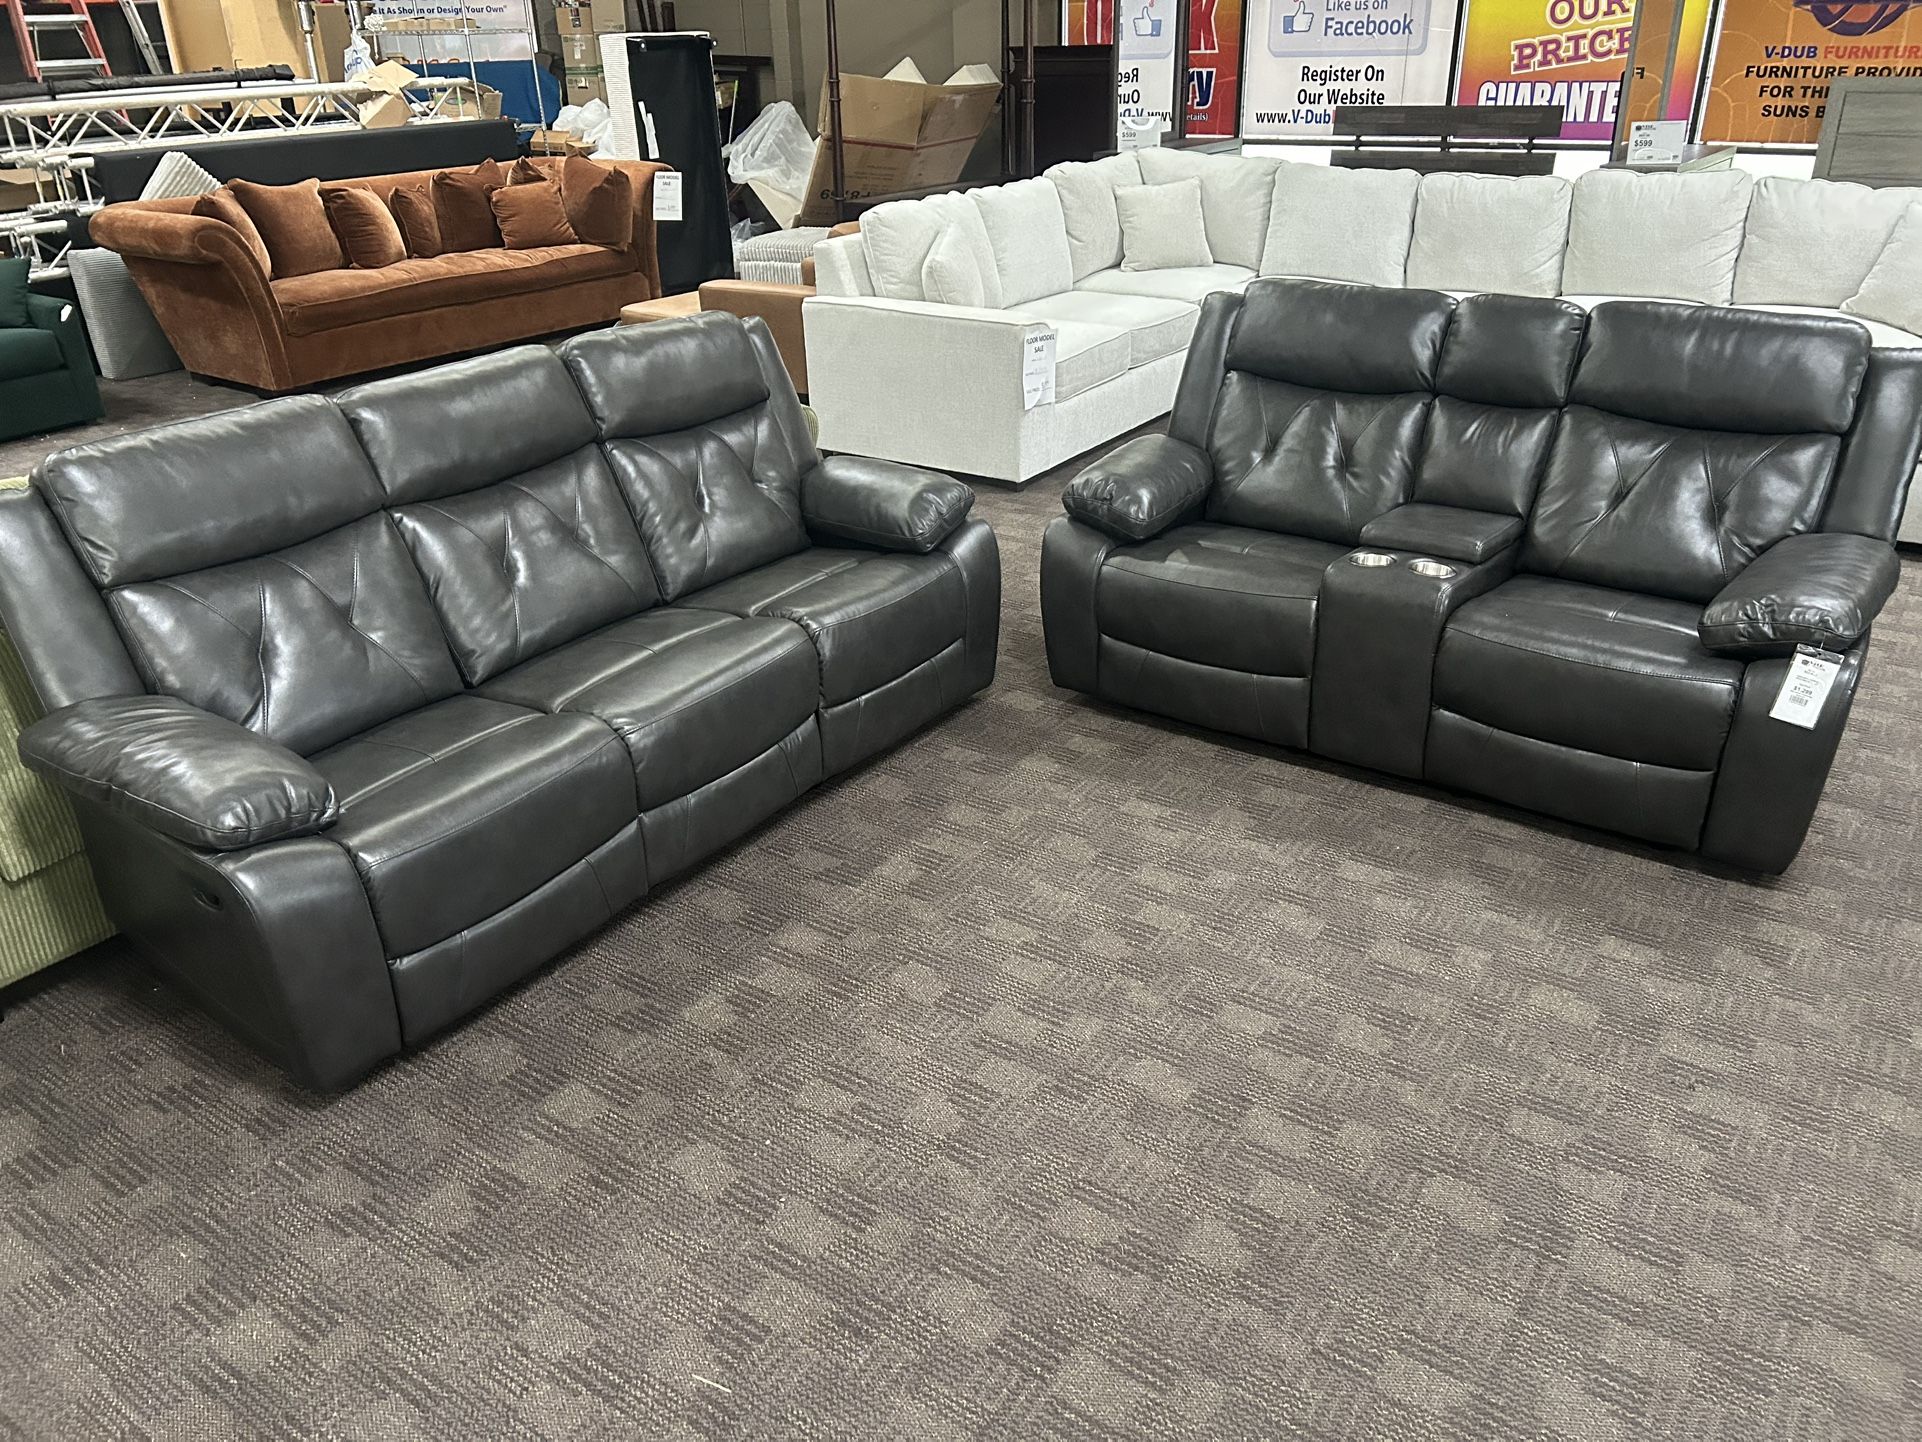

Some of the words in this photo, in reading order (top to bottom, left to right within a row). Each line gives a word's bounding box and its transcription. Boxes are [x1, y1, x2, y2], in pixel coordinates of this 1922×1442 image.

[379, 7, 385, 15] It
[465, 5, 484, 13] Your
[1326, 0, 1351, 11] Like
[1355, 0, 1369, 10] us
[1372, 0, 1388, 10] on
[1324, 13, 1414, 37] Facebook
[1764, 46, 1818, 59] V-DUB
[1823, 45, 1922, 60] FURNITUR
[1301, 65, 1361, 86] Register
[1364, 65, 1385, 82] On
[1854, 65, 1922, 77] PROVID
[1297, 88, 1324, 105] Our
[1326, 88, 1385, 105] Website
[1758, 85, 1795, 98] FOR
[1477, 80, 1621, 123] GUARANTE
[1186, 113, 1209, 121] etails)
[1255, 109, 1336, 124] www.V-Dub
[1761, 104, 1810, 118] SUNS
[1815, 105, 1826, 118] B
[1634, 139, 1653, 147] $599
[1039, 333, 1055, 341] MODEL
[1034, 344, 1044, 354] SALE
